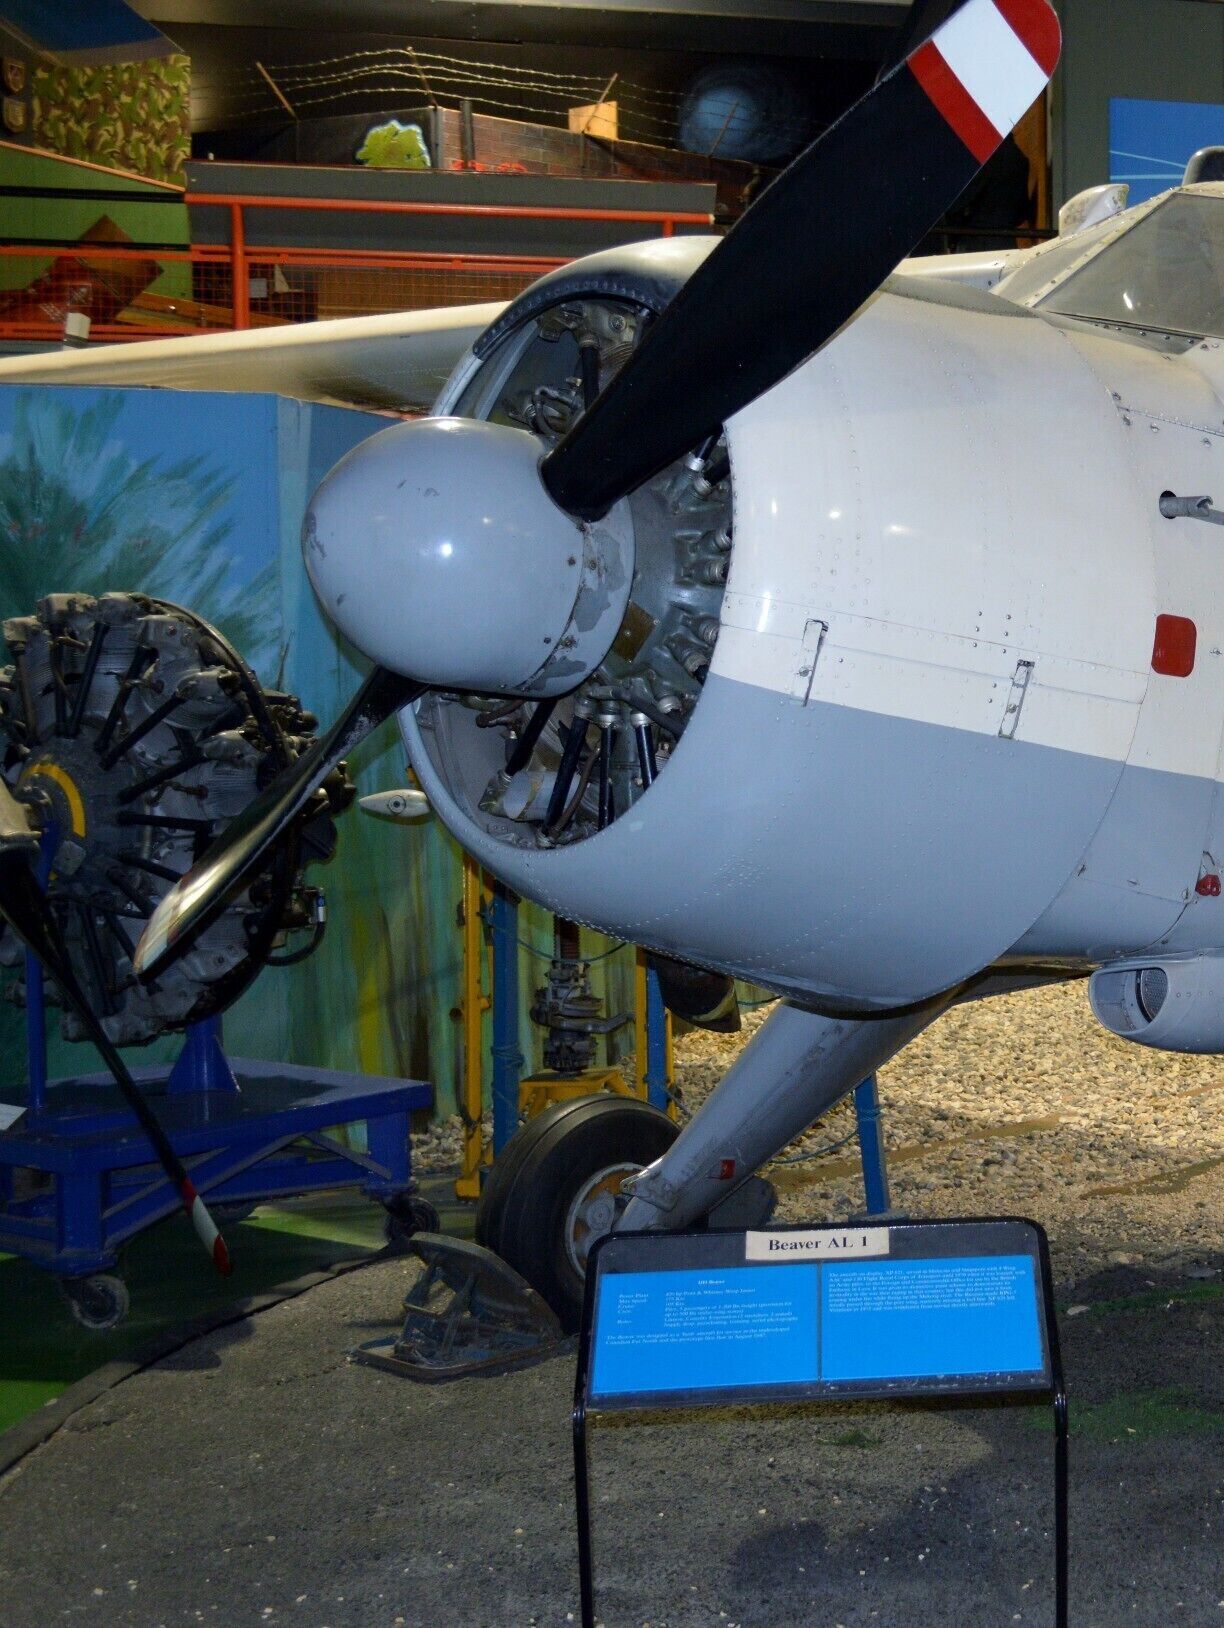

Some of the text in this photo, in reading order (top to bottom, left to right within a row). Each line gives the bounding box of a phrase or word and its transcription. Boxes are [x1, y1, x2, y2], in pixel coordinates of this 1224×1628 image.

[769, 1235, 868, 1251] Beaver AL 1
